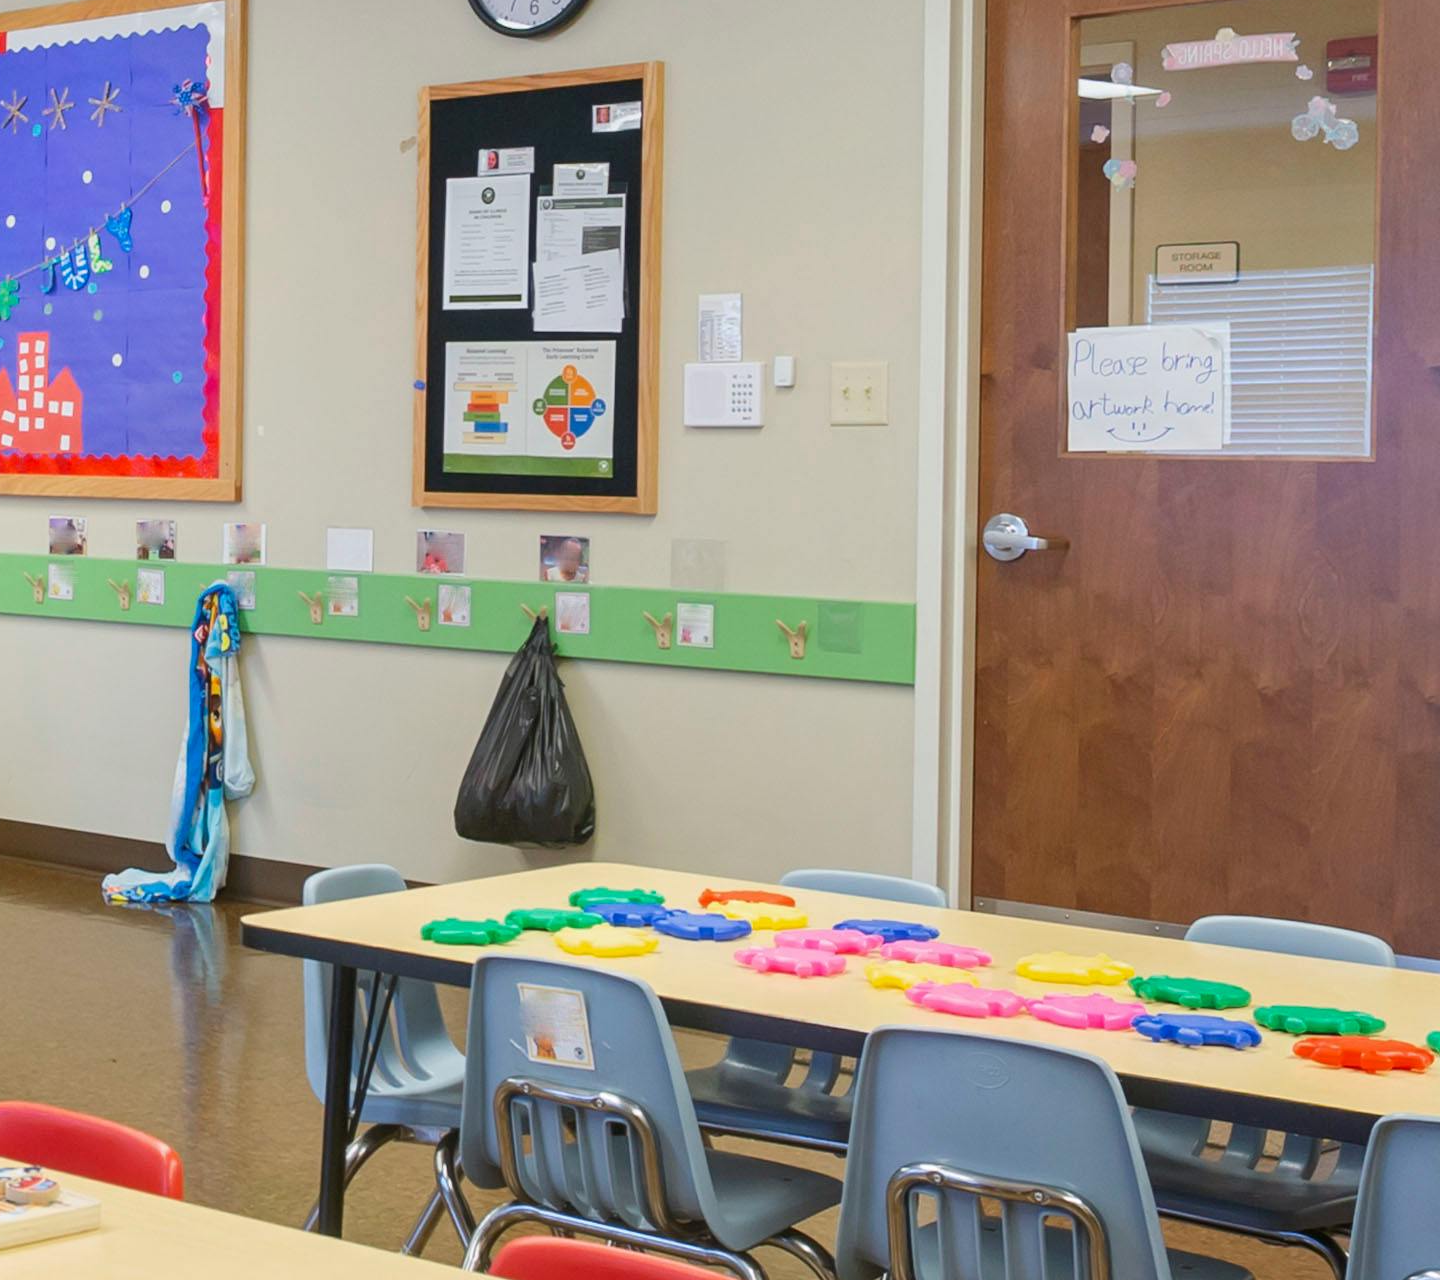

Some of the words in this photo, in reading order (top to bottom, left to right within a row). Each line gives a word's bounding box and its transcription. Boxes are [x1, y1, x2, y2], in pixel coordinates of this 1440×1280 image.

[530, 0, 539, 15] 6
[39, 207, 134, 294] JULY
[1171, 249, 1221, 262] STORAGE
[1179, 261, 1213, 273] ROOM
[1073, 338, 1148, 377] Please
[1162, 341, 1218, 384] bring
[1072, 393, 1155, 420] artwork
[1163, 390, 1215, 415] home!
